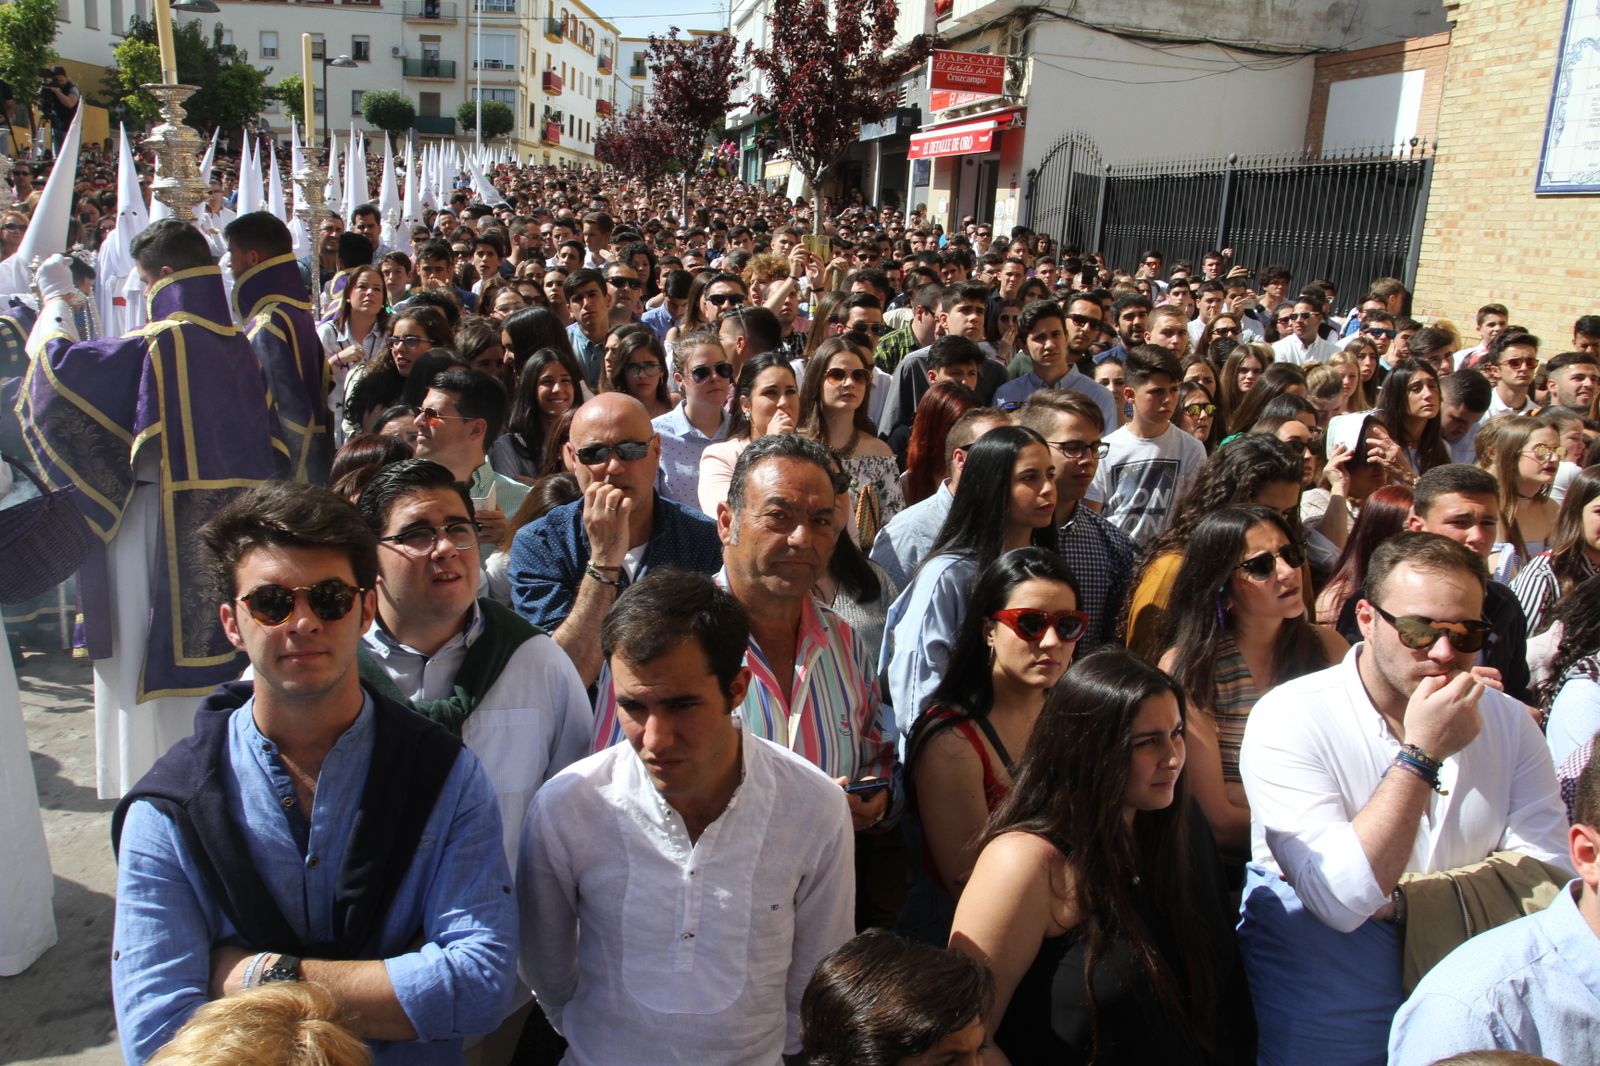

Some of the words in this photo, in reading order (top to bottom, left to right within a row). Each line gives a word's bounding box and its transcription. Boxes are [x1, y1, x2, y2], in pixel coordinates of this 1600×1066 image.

[936, 62, 946, 70] El
[947, 64, 973, 73] detalle
[985, 67, 1001, 76] Oro
[947, 73, 987, 85] Cruzcampo
[922, 142, 930, 155] EL
[929, 138, 951, 154] DETALLE
[951, 137, 960, 152] DE
[960, 135, 973, 151] ORO
